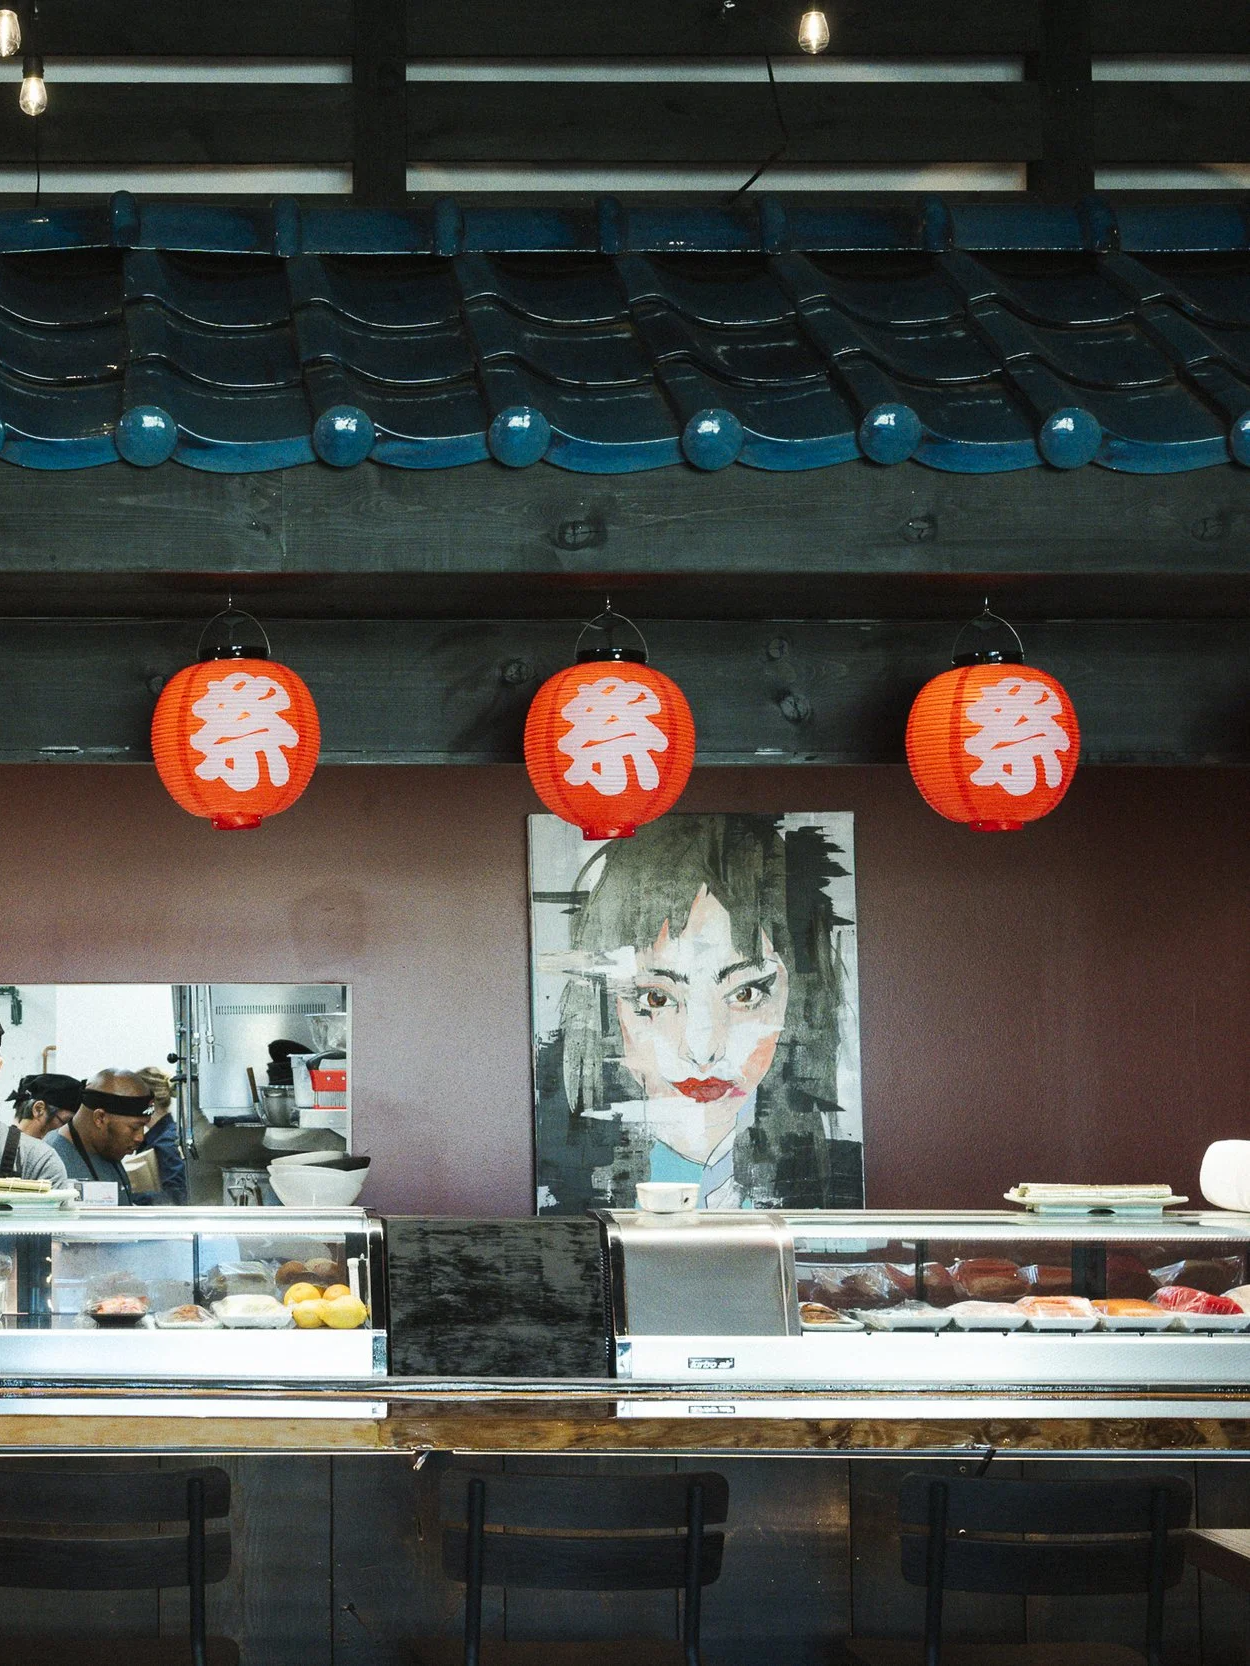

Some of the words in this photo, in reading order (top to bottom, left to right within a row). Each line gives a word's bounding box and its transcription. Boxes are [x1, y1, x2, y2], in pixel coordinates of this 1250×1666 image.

[189, 672, 300, 792] 祭
[557, 676, 669, 796] 祭
[963, 677, 1071, 796] 祭
